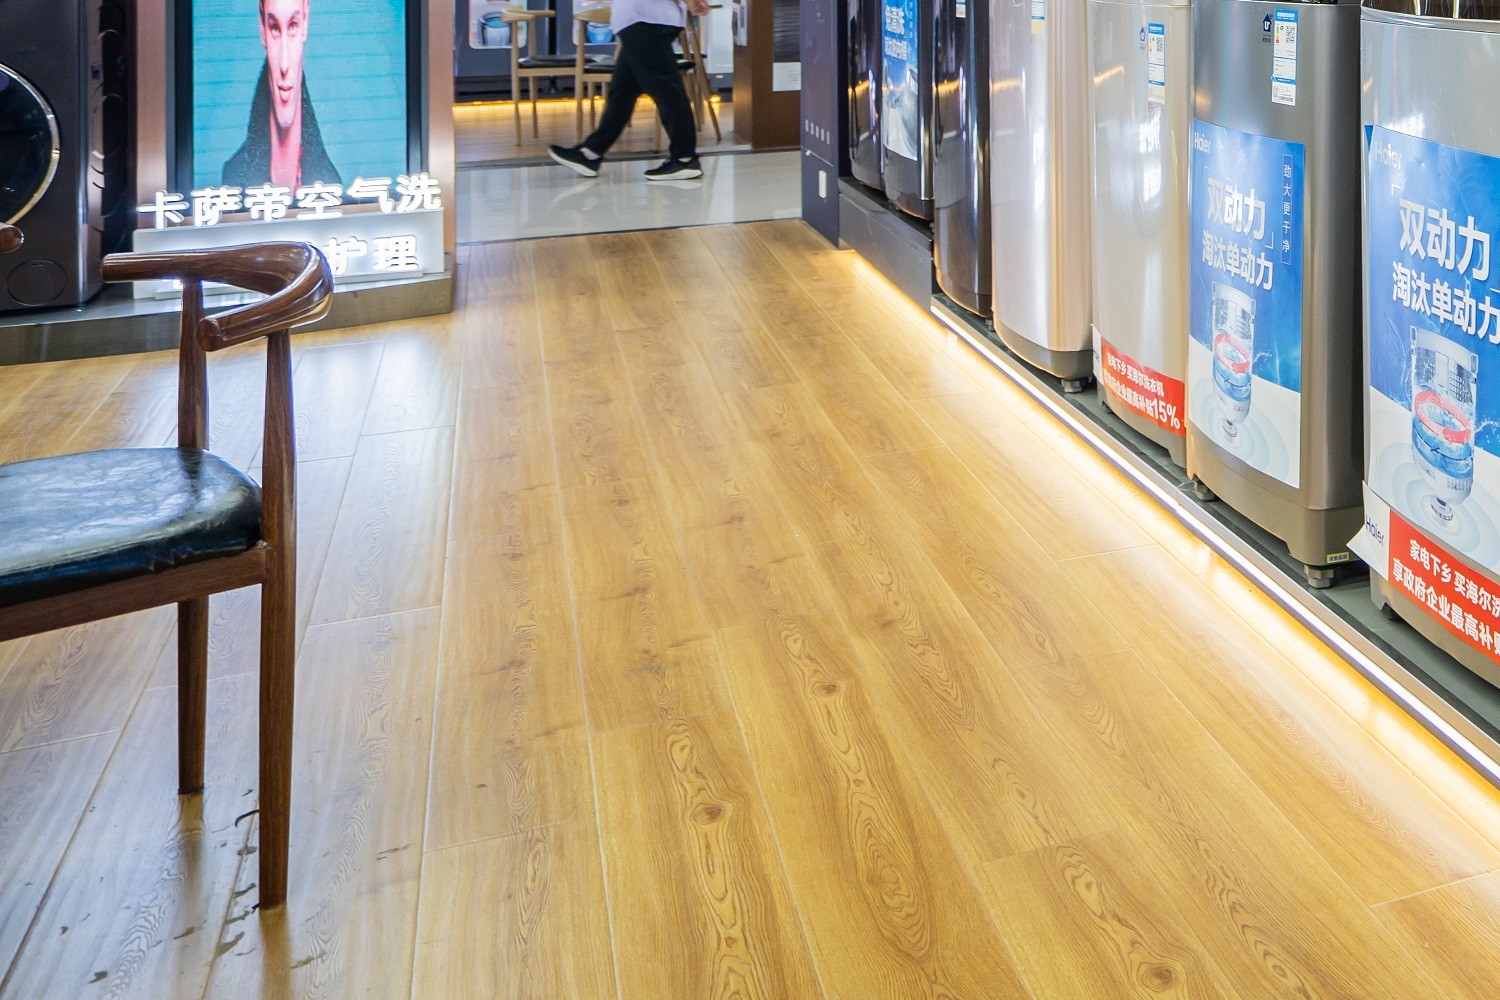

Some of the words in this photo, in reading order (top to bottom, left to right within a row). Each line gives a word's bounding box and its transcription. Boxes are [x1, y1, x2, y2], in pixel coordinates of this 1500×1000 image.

[1194, 130, 1211, 156] Haier
[1373, 140, 1403, 171] Haier
[137, 172, 442, 230] 卡萨帝空气洗
[1207, 178, 1266, 241] 双动力
[1201, 229, 1274, 292] 淘汰单动力
[1398, 199, 1490, 282] 双动力
[1365, 514, 1385, 547] Haier
[1409, 538, 1453, 584] 家电下乡
